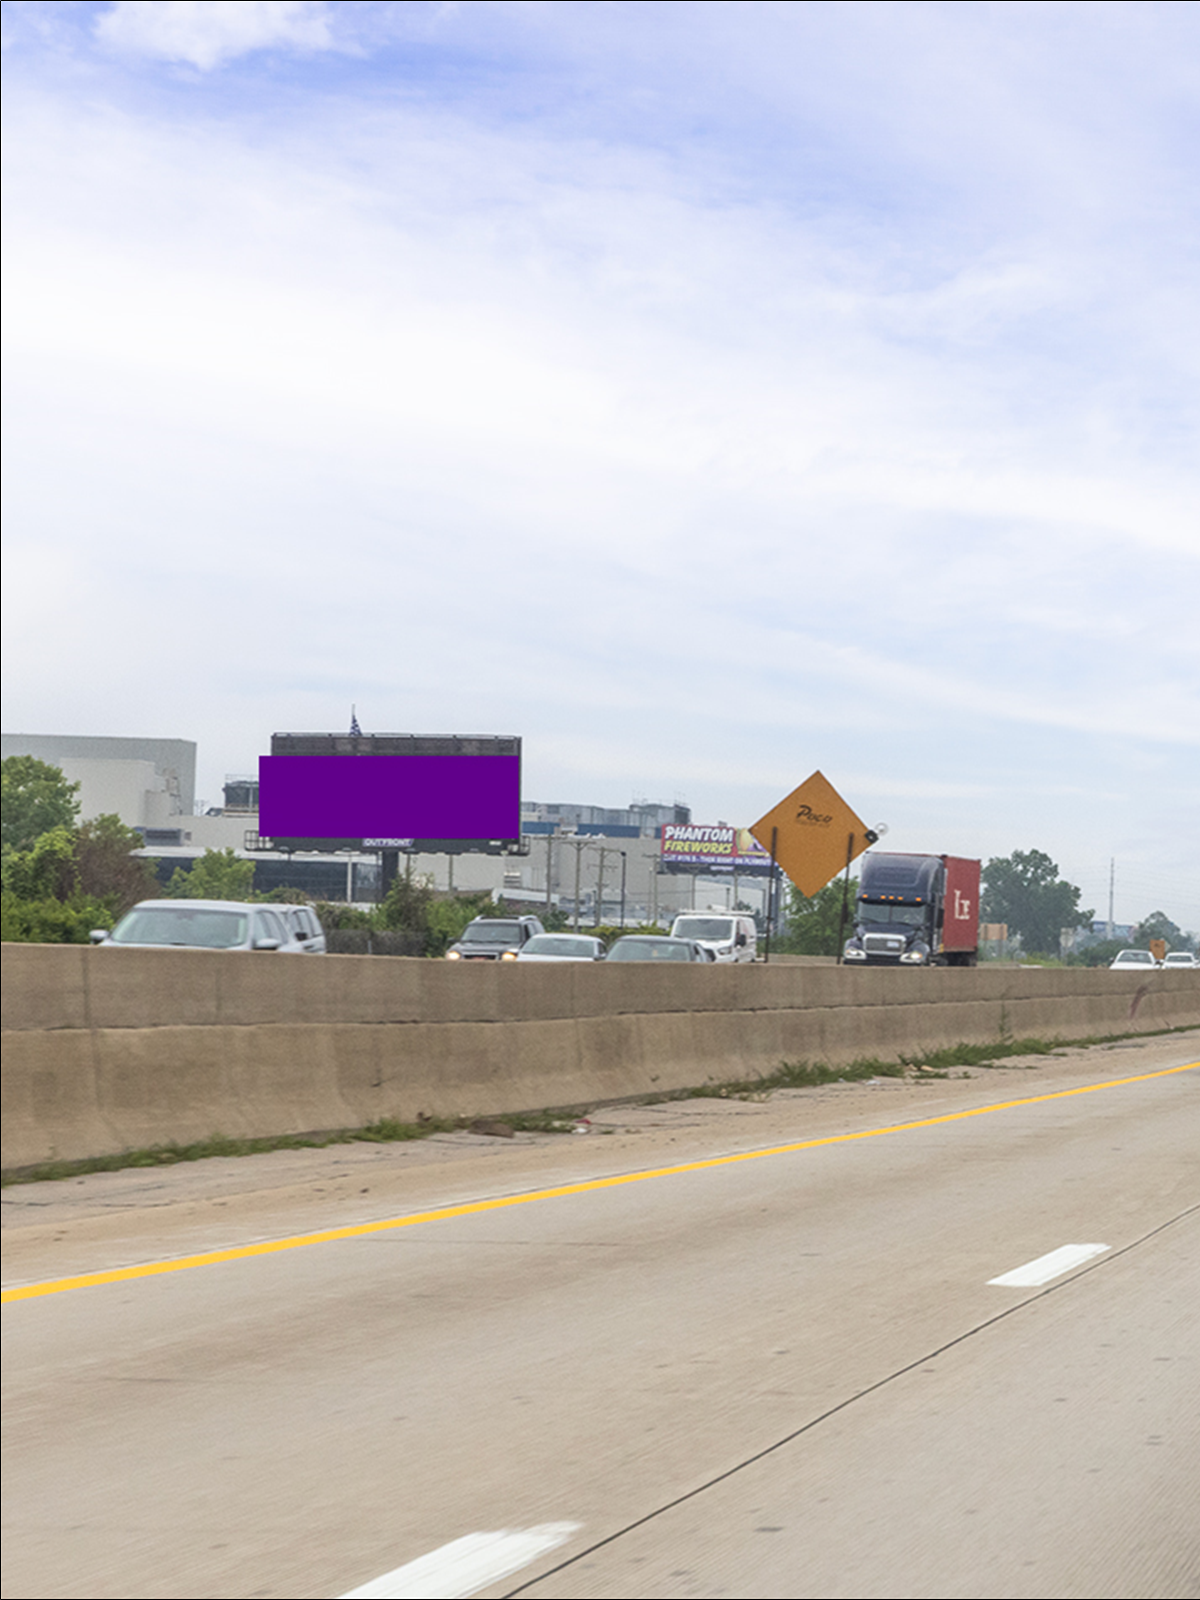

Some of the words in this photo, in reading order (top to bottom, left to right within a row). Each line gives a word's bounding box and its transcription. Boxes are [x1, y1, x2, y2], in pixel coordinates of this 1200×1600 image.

[664, 826, 735, 842] PHANTOM
[364, 837, 411, 847] OUTFRONT
[663, 840, 734, 855] FIREWORKS
